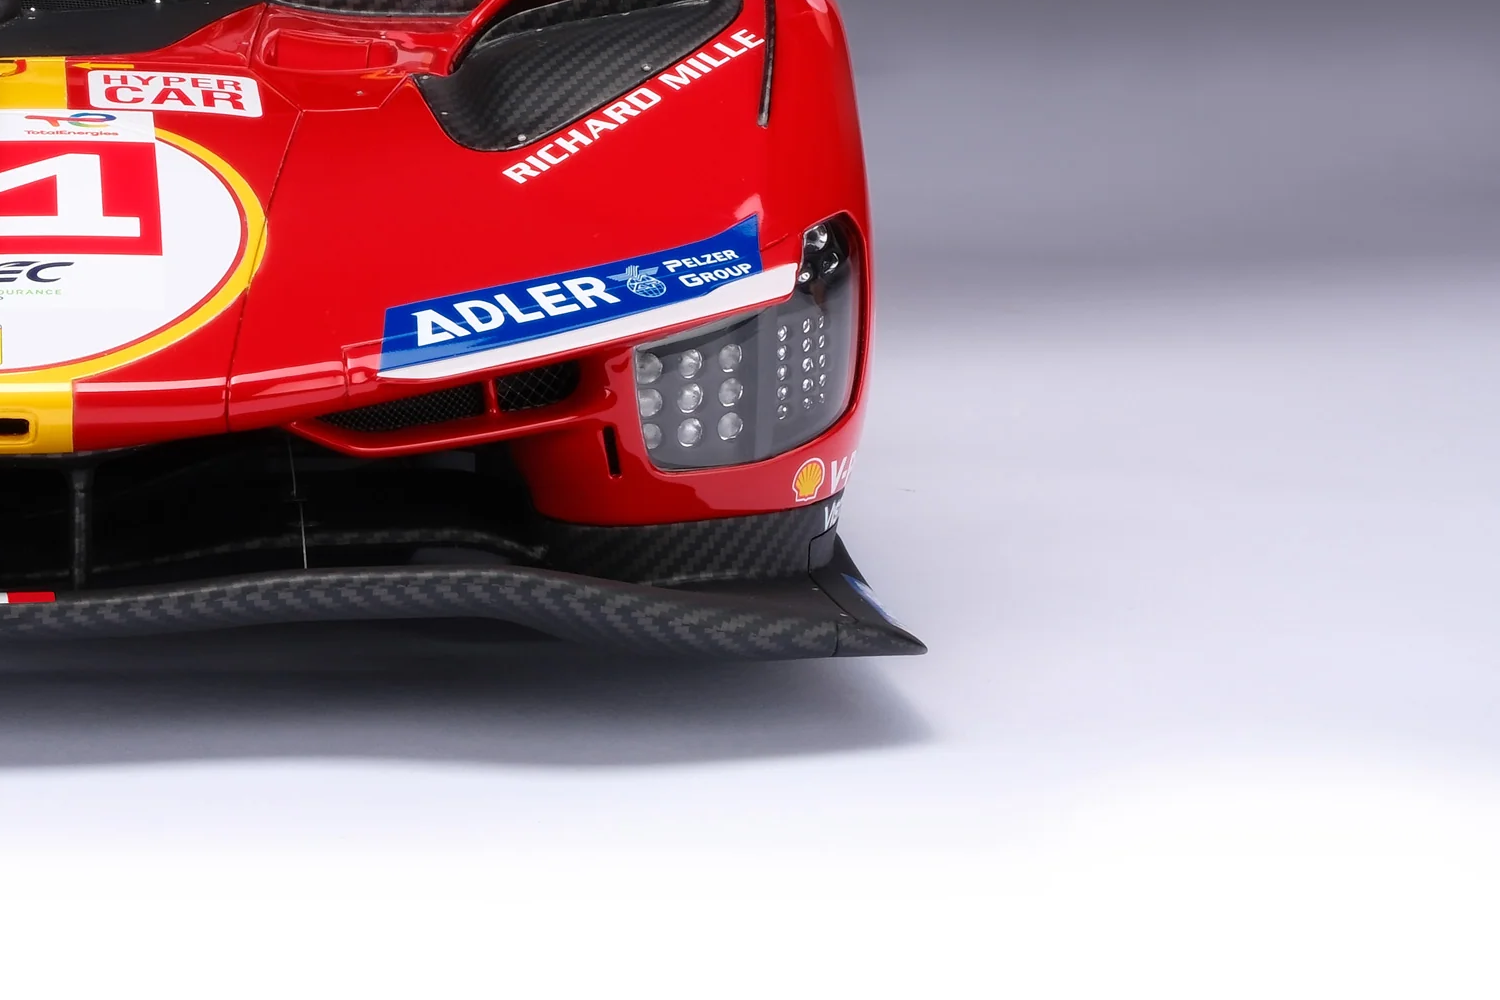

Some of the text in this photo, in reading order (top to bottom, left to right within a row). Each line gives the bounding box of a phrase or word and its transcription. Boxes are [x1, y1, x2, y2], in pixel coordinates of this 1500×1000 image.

[103, 75, 243, 91] HYPER
[105, 86, 246, 111] CAR
[502, 29, 765, 184] RICHARD MILLE
[24, 129, 119, 137] TotalEnergies
[411, 276, 621, 347] ADLER
